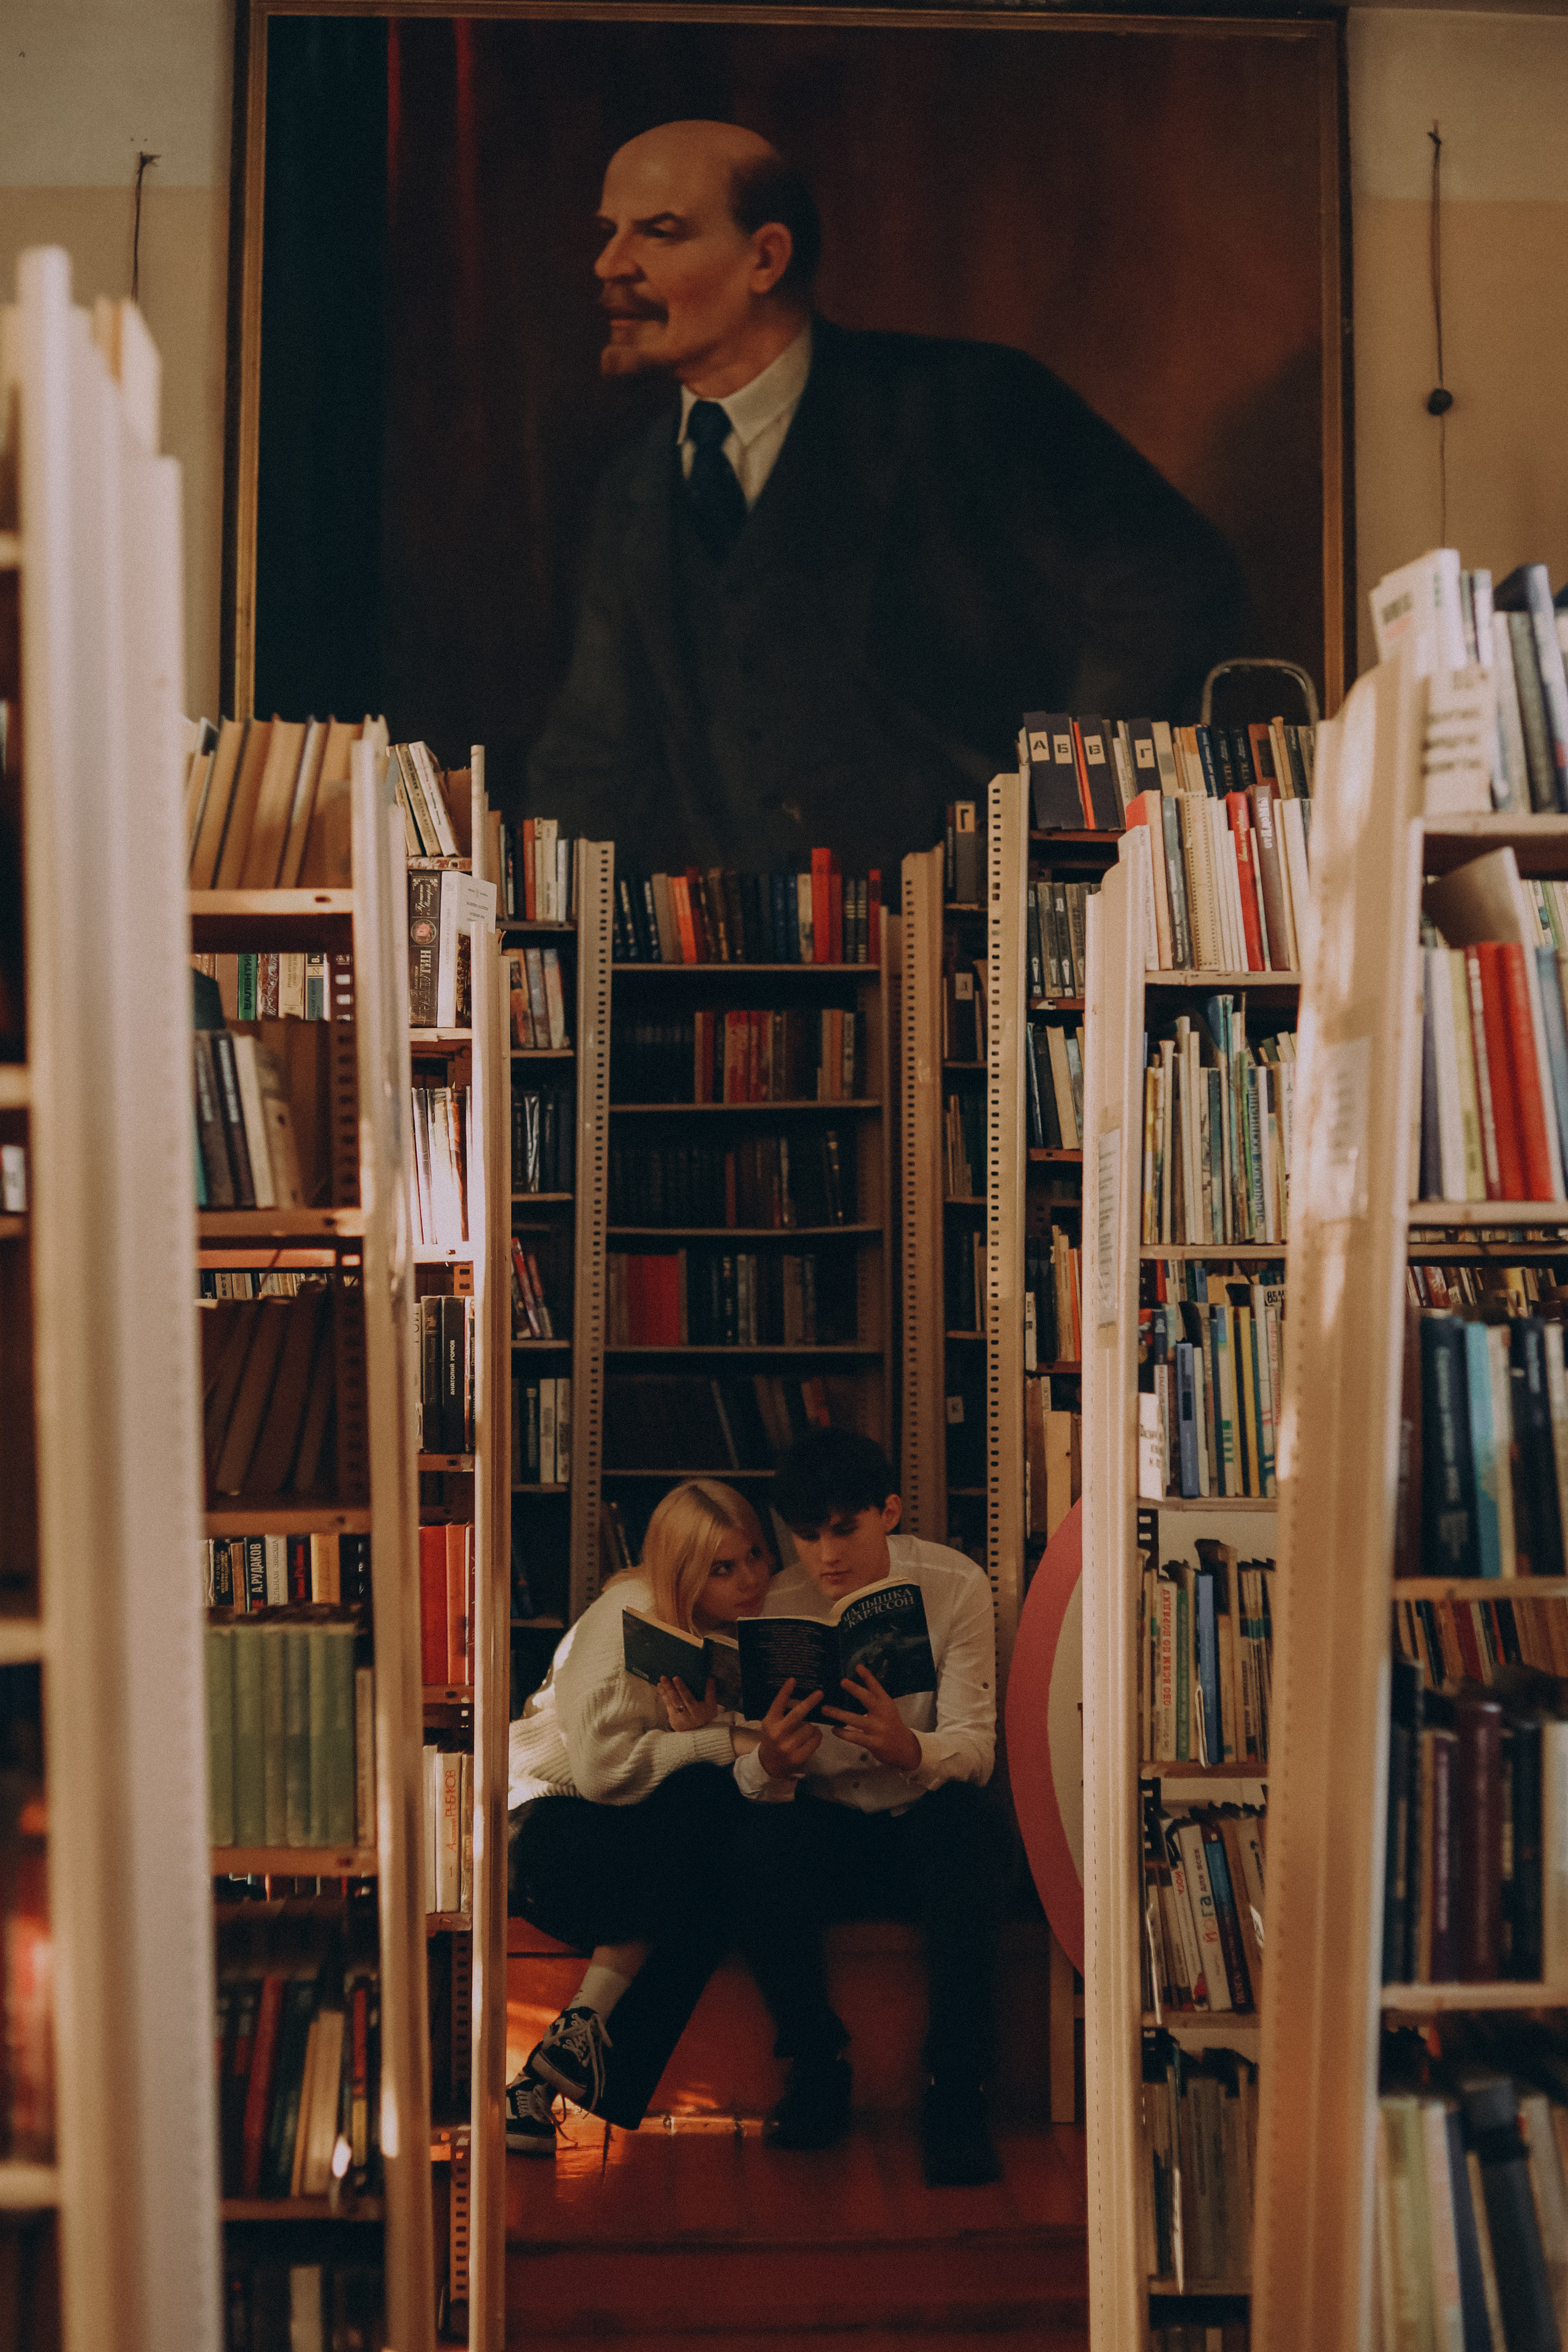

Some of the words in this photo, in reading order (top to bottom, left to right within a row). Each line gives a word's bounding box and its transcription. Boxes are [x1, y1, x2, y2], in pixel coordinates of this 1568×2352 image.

[1033, 740, 1046, 750] А
[1058, 743, 1069, 753] Б
[1088, 745, 1101, 755] В
[1140, 748, 1151, 758] Г
[960, 809, 969, 829] Г
[249, 1543, 265, 1593] А.РУДАКОВ
[843, 1588, 913, 1622] МАЛЫШКА
[848, 1596, 914, 1629] КАРЛССОН
[1163, 1589, 1172, 1637] ПОРЯДКУ
[1163, 1640, 1170, 1653] ПО
[1175, 1870, 1185, 1895] ЙОГА
